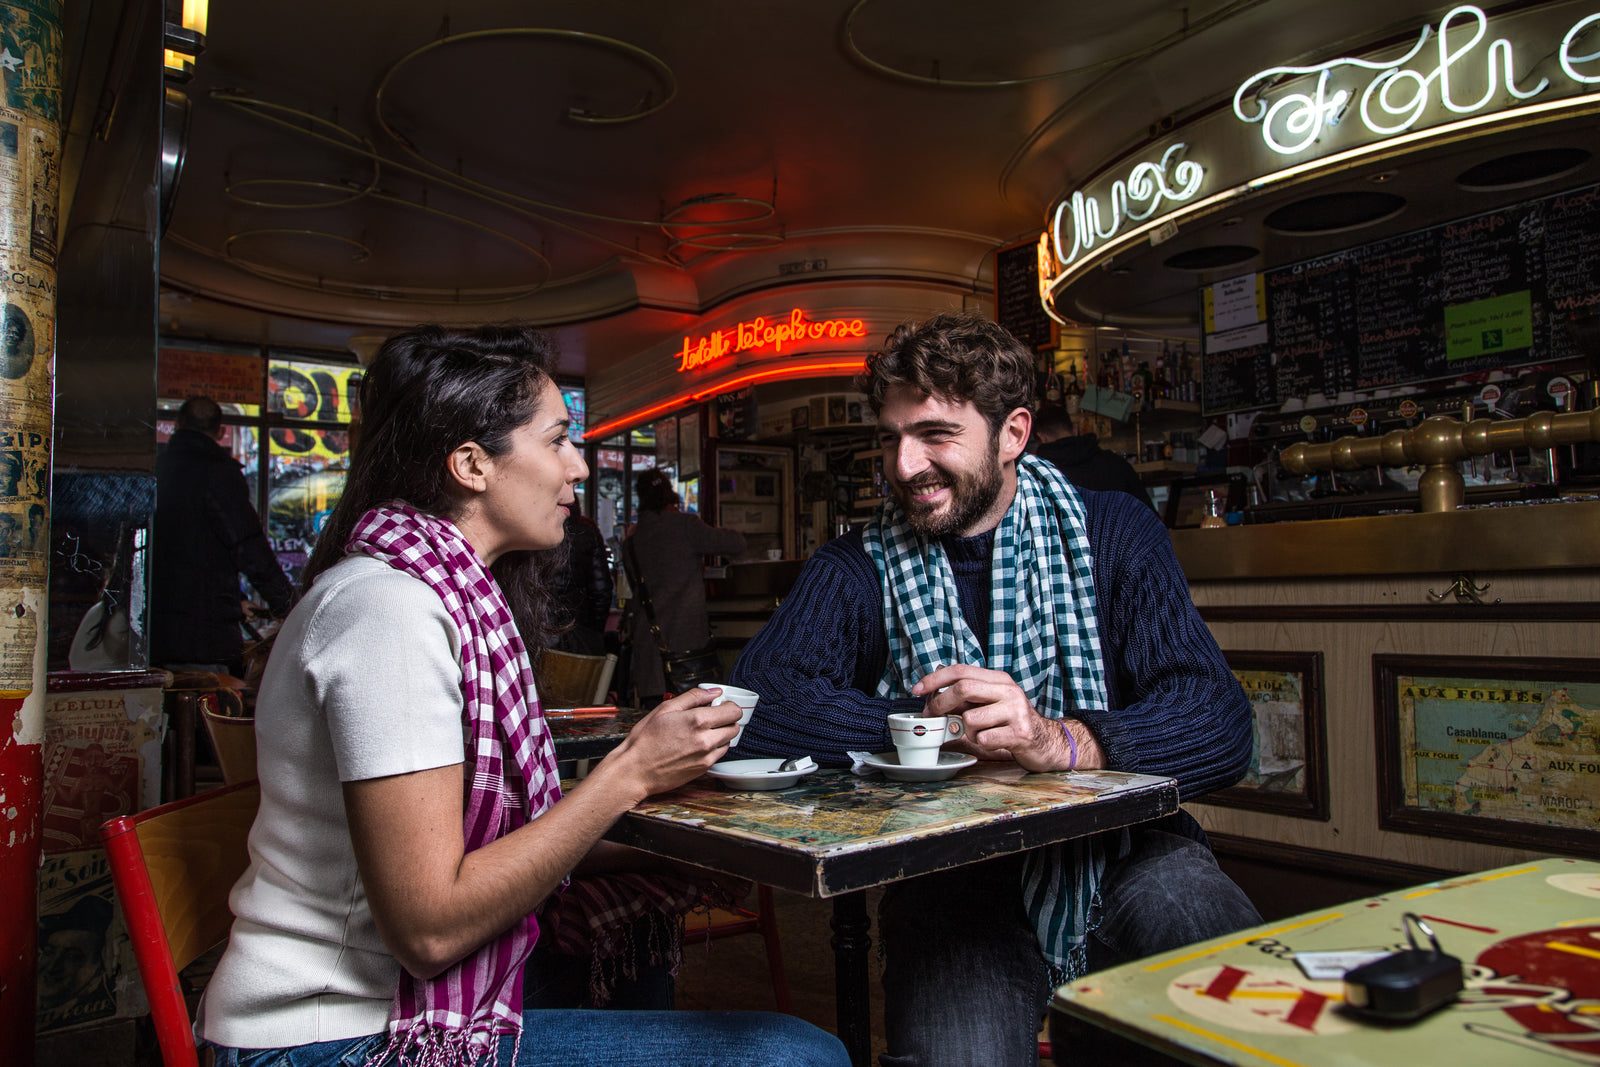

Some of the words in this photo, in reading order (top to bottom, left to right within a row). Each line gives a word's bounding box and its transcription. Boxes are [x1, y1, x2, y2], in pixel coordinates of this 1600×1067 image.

[1404, 687, 1447, 698] AUX
[1457, 689, 1543, 702] FOLIES
[46, 699, 125, 713] LELUIA
[1446, 726, 1508, 741] Casablanca
[1414, 750, 1431, 759] AUX
[1433, 752, 1460, 760] FOLIES
[1548, 760, 1576, 772] AUX
[1539, 794, 1581, 810] MAROC
